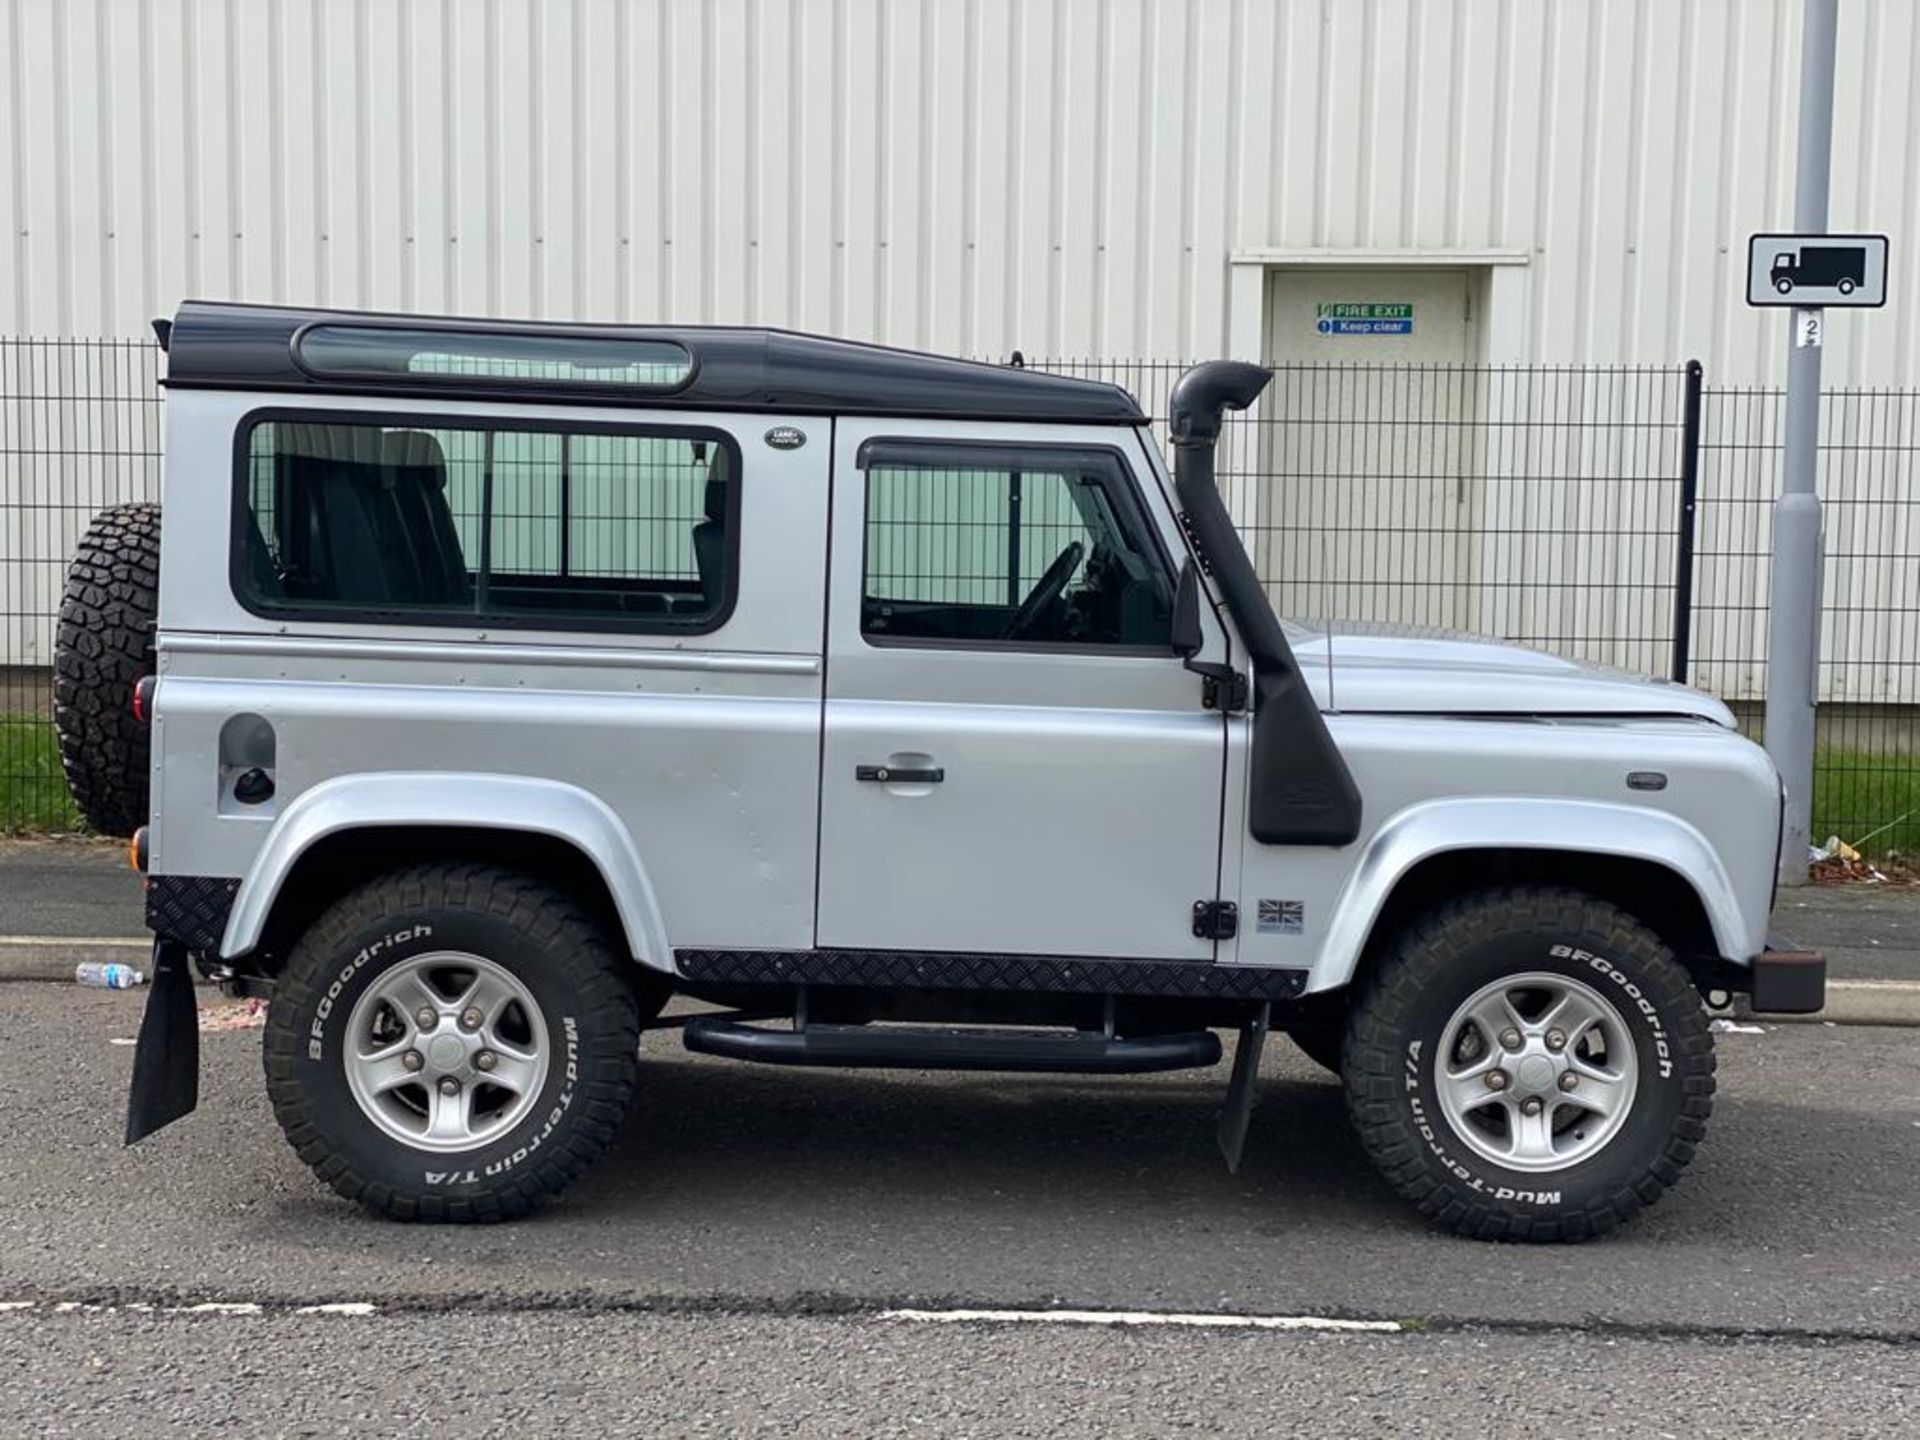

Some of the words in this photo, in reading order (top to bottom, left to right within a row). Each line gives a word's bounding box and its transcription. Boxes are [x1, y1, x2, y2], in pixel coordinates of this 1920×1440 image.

[1335, 304, 1369, 316] FIRE
[1374, 304, 1407, 316] EXIT
[1340, 322, 1371, 332] Keep
[1374, 321, 1403, 331] clear
[308, 924, 433, 1061] BFGoodrich
[1549, 944, 1673, 1078] BFGoodrich
[485, 1016, 579, 1176] Mud-Terrain
[1404, 1039, 1423, 1091] T/A
[425, 1170, 480, 1186] T/A
[1410, 1098, 1562, 1205] Mud-Terrain
